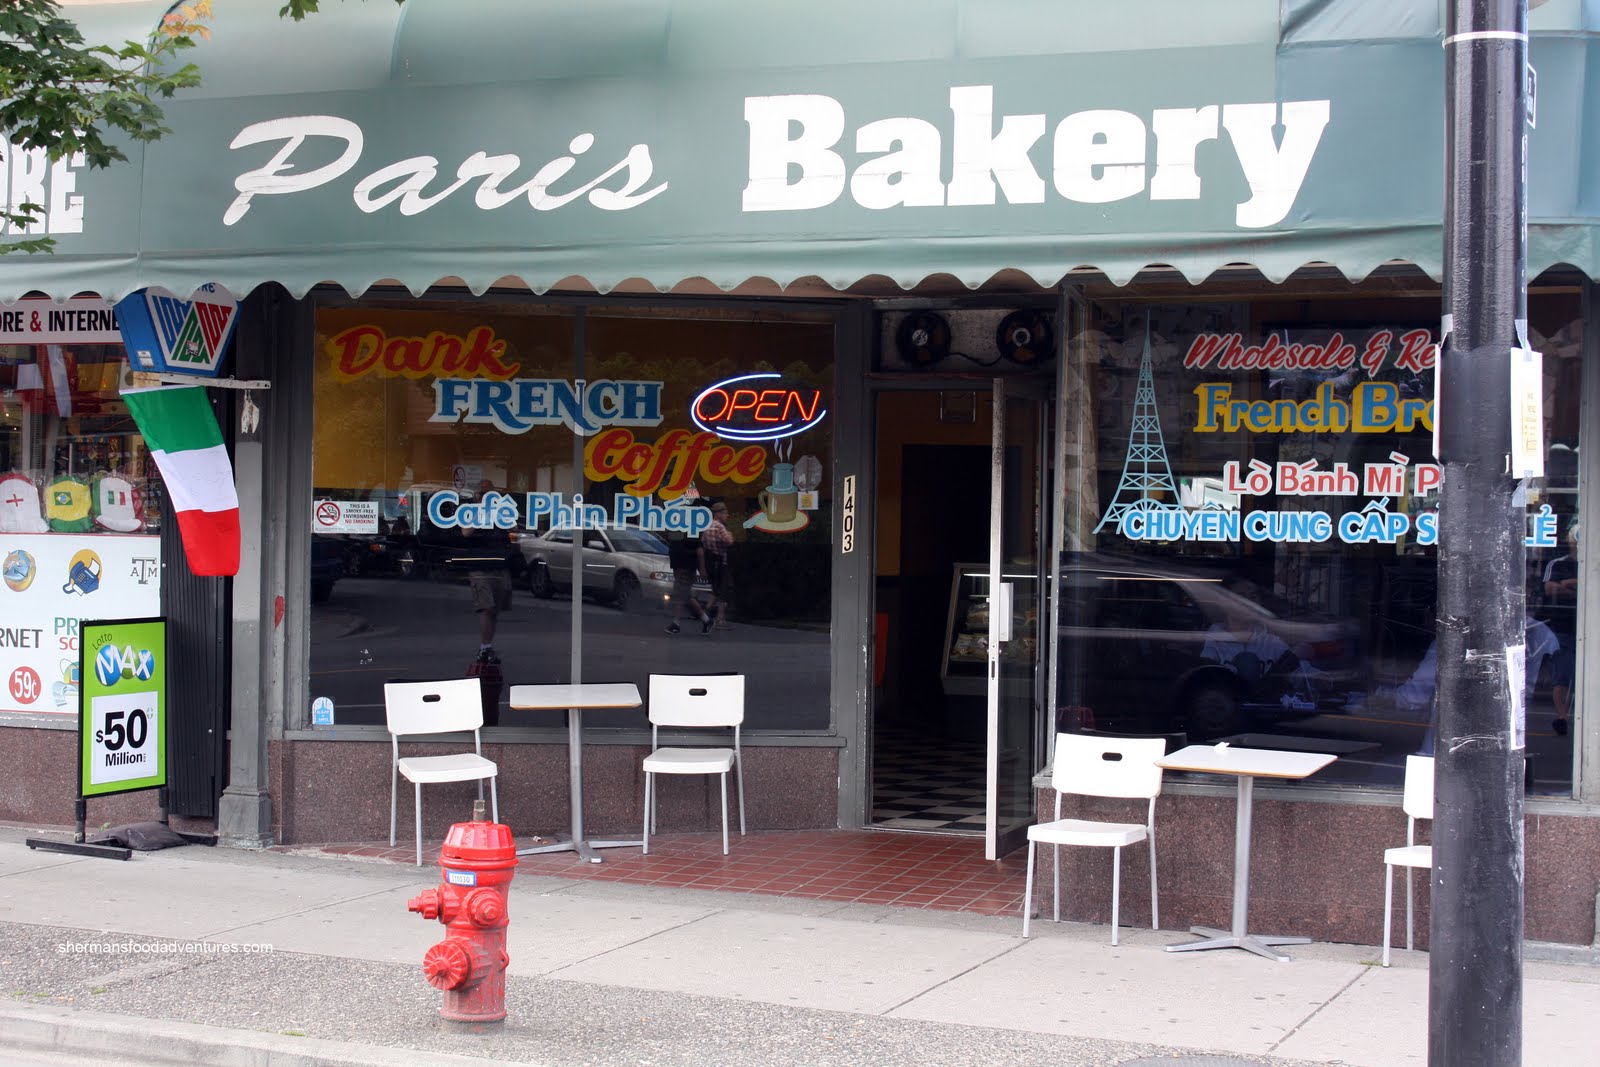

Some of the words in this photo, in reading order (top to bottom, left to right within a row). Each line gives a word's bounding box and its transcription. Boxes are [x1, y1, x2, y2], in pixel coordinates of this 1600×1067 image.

[223, 115, 668, 225] Paris
[742, 85, 1330, 228] Bakery
[0, 131, 86, 234] RE
[0, 311, 24, 332] RE
[30, 310, 42, 332] &
[330, 326, 520, 382] Dark
[1184, 333, 1355, 370] Wholesale
[1361, 329, 1392, 377] &
[429, 378, 664, 435] FRENCH
[696, 389, 820, 421] OPEN
[1193, 382, 1349, 432] French
[1352, 382, 1433, 433] Br
[585, 429, 767, 499] Coffee
[1224, 459, 1272, 495] Lò
[1276, 458, 1358, 496] Bánh
[1364, 451, 1410, 496] Mì
[526, 491, 607, 530] Phin
[614, 493, 713, 538] Pháp
[843, 476, 854, 553] 1403
[1123, 501, 1240, 541] CHUYÊN
[1244, 511, 1332, 542] CUNG
[1338, 496, 1409, 543] CẤP
[1416, 502, 1439, 545] S
[92, 633, 113, 650] Lotto
[96, 644, 153, 685] MAX
[96, 708, 147, 750] $50
[105, 752, 143, 767] Million
